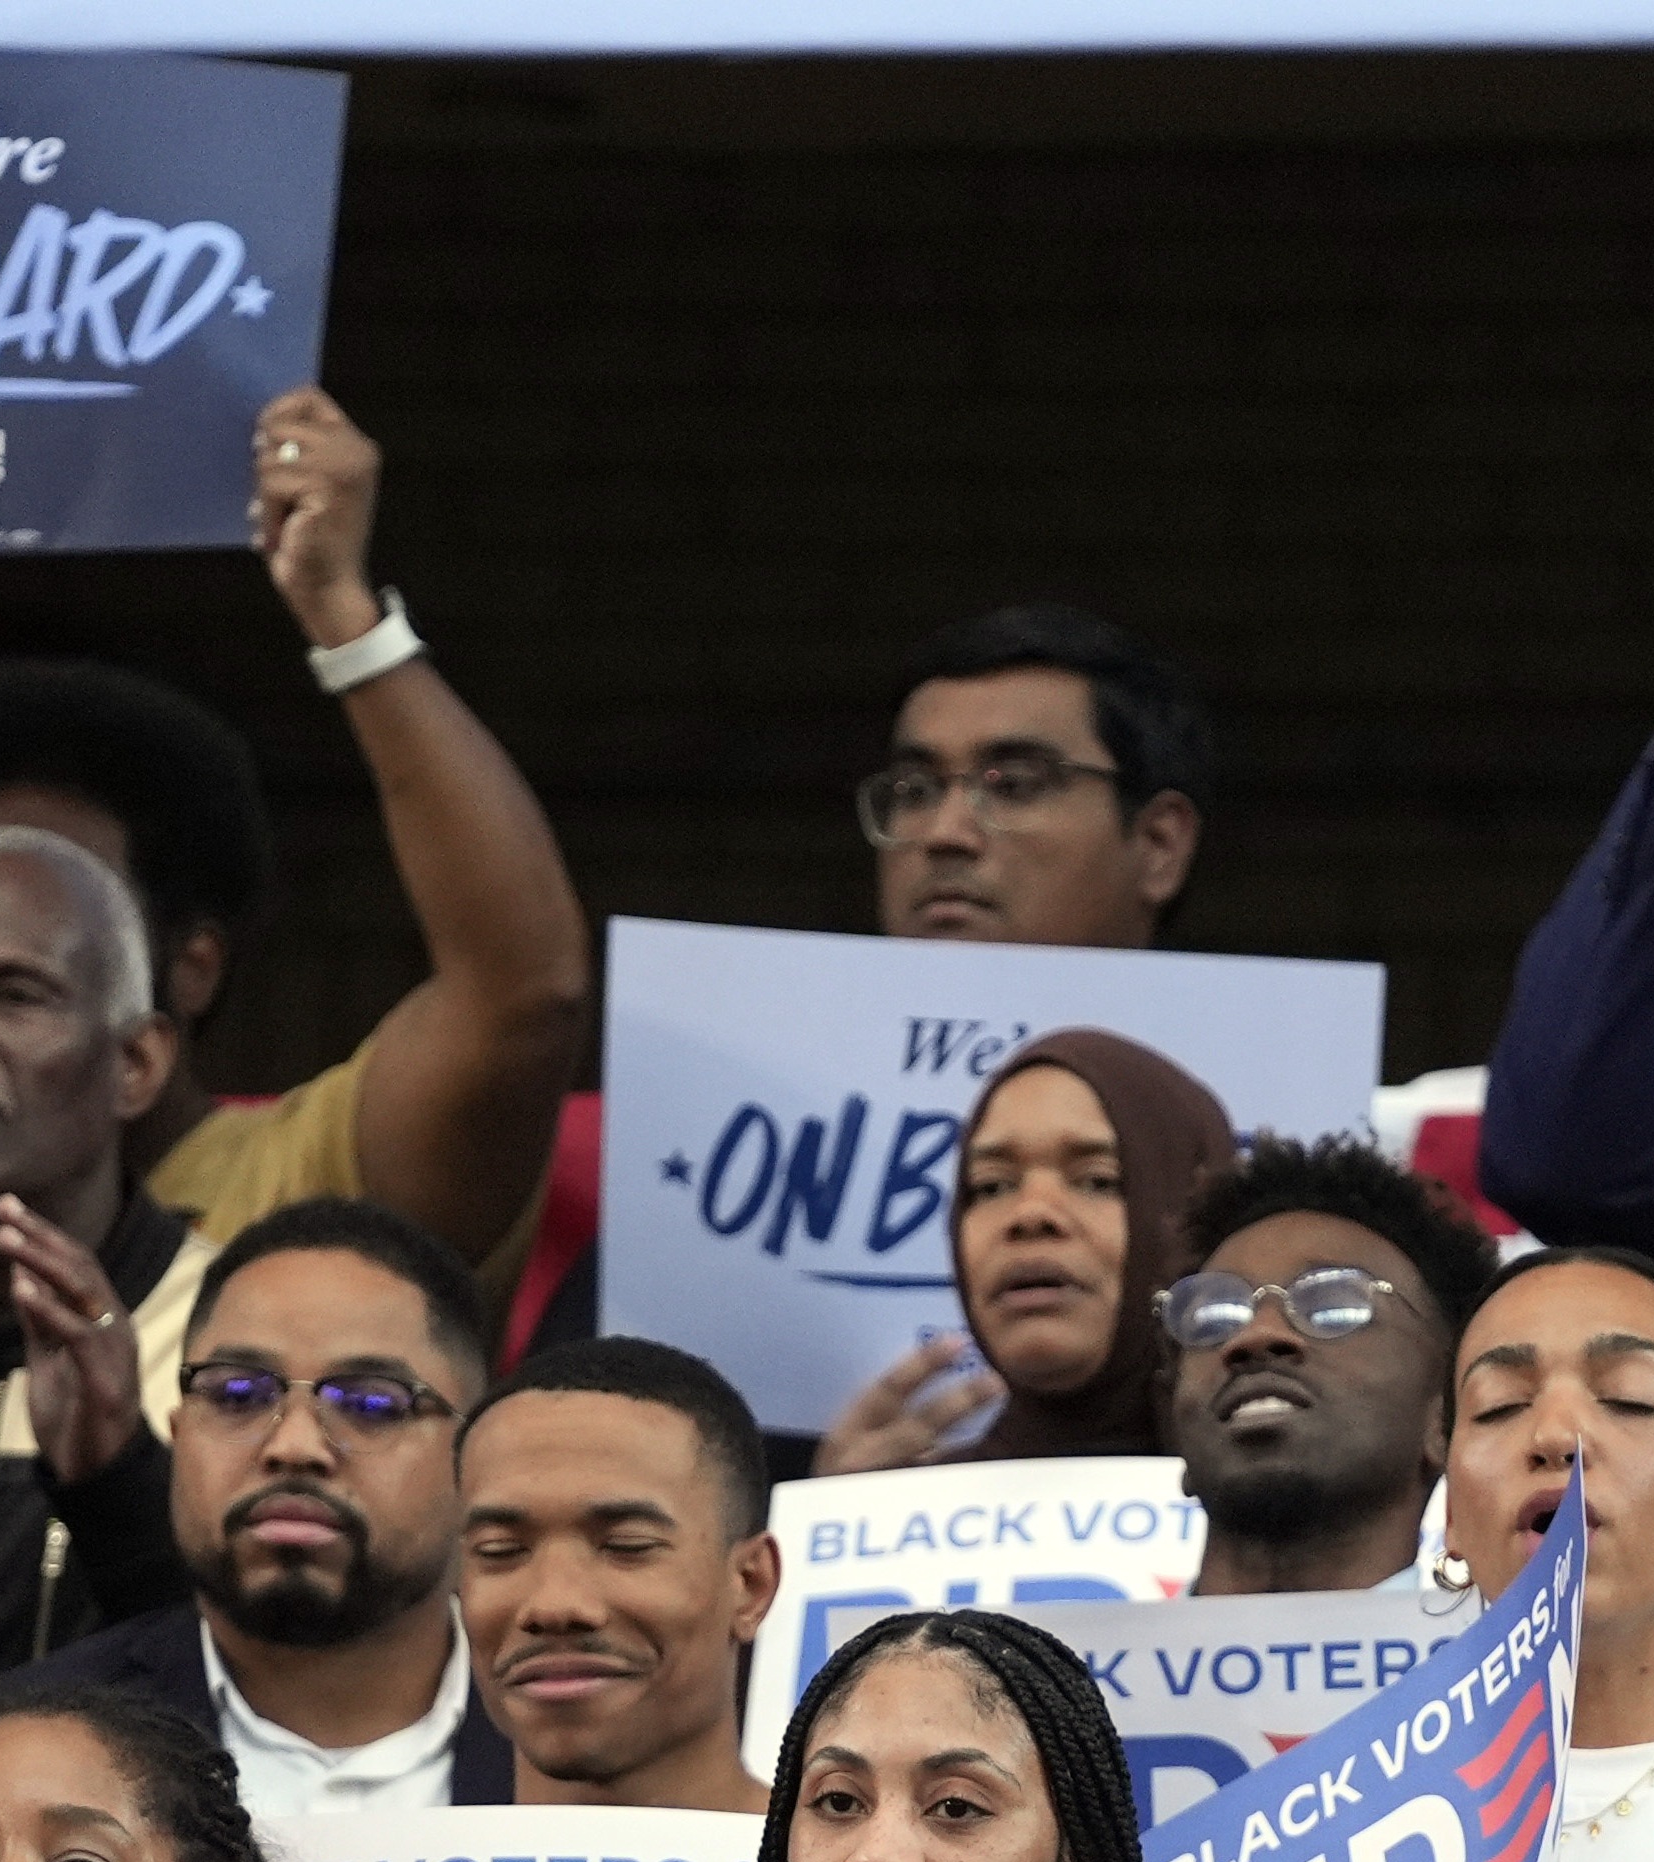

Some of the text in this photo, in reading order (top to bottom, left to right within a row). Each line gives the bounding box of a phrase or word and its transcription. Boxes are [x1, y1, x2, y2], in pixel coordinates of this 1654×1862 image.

[901, 1015, 1030, 1079] We'
[806, 1498, 1203, 1564] BLACK VOT
[1158, 1637, 1458, 1698] VOTER
[1370, 1587, 1551, 1780] VOTERS
